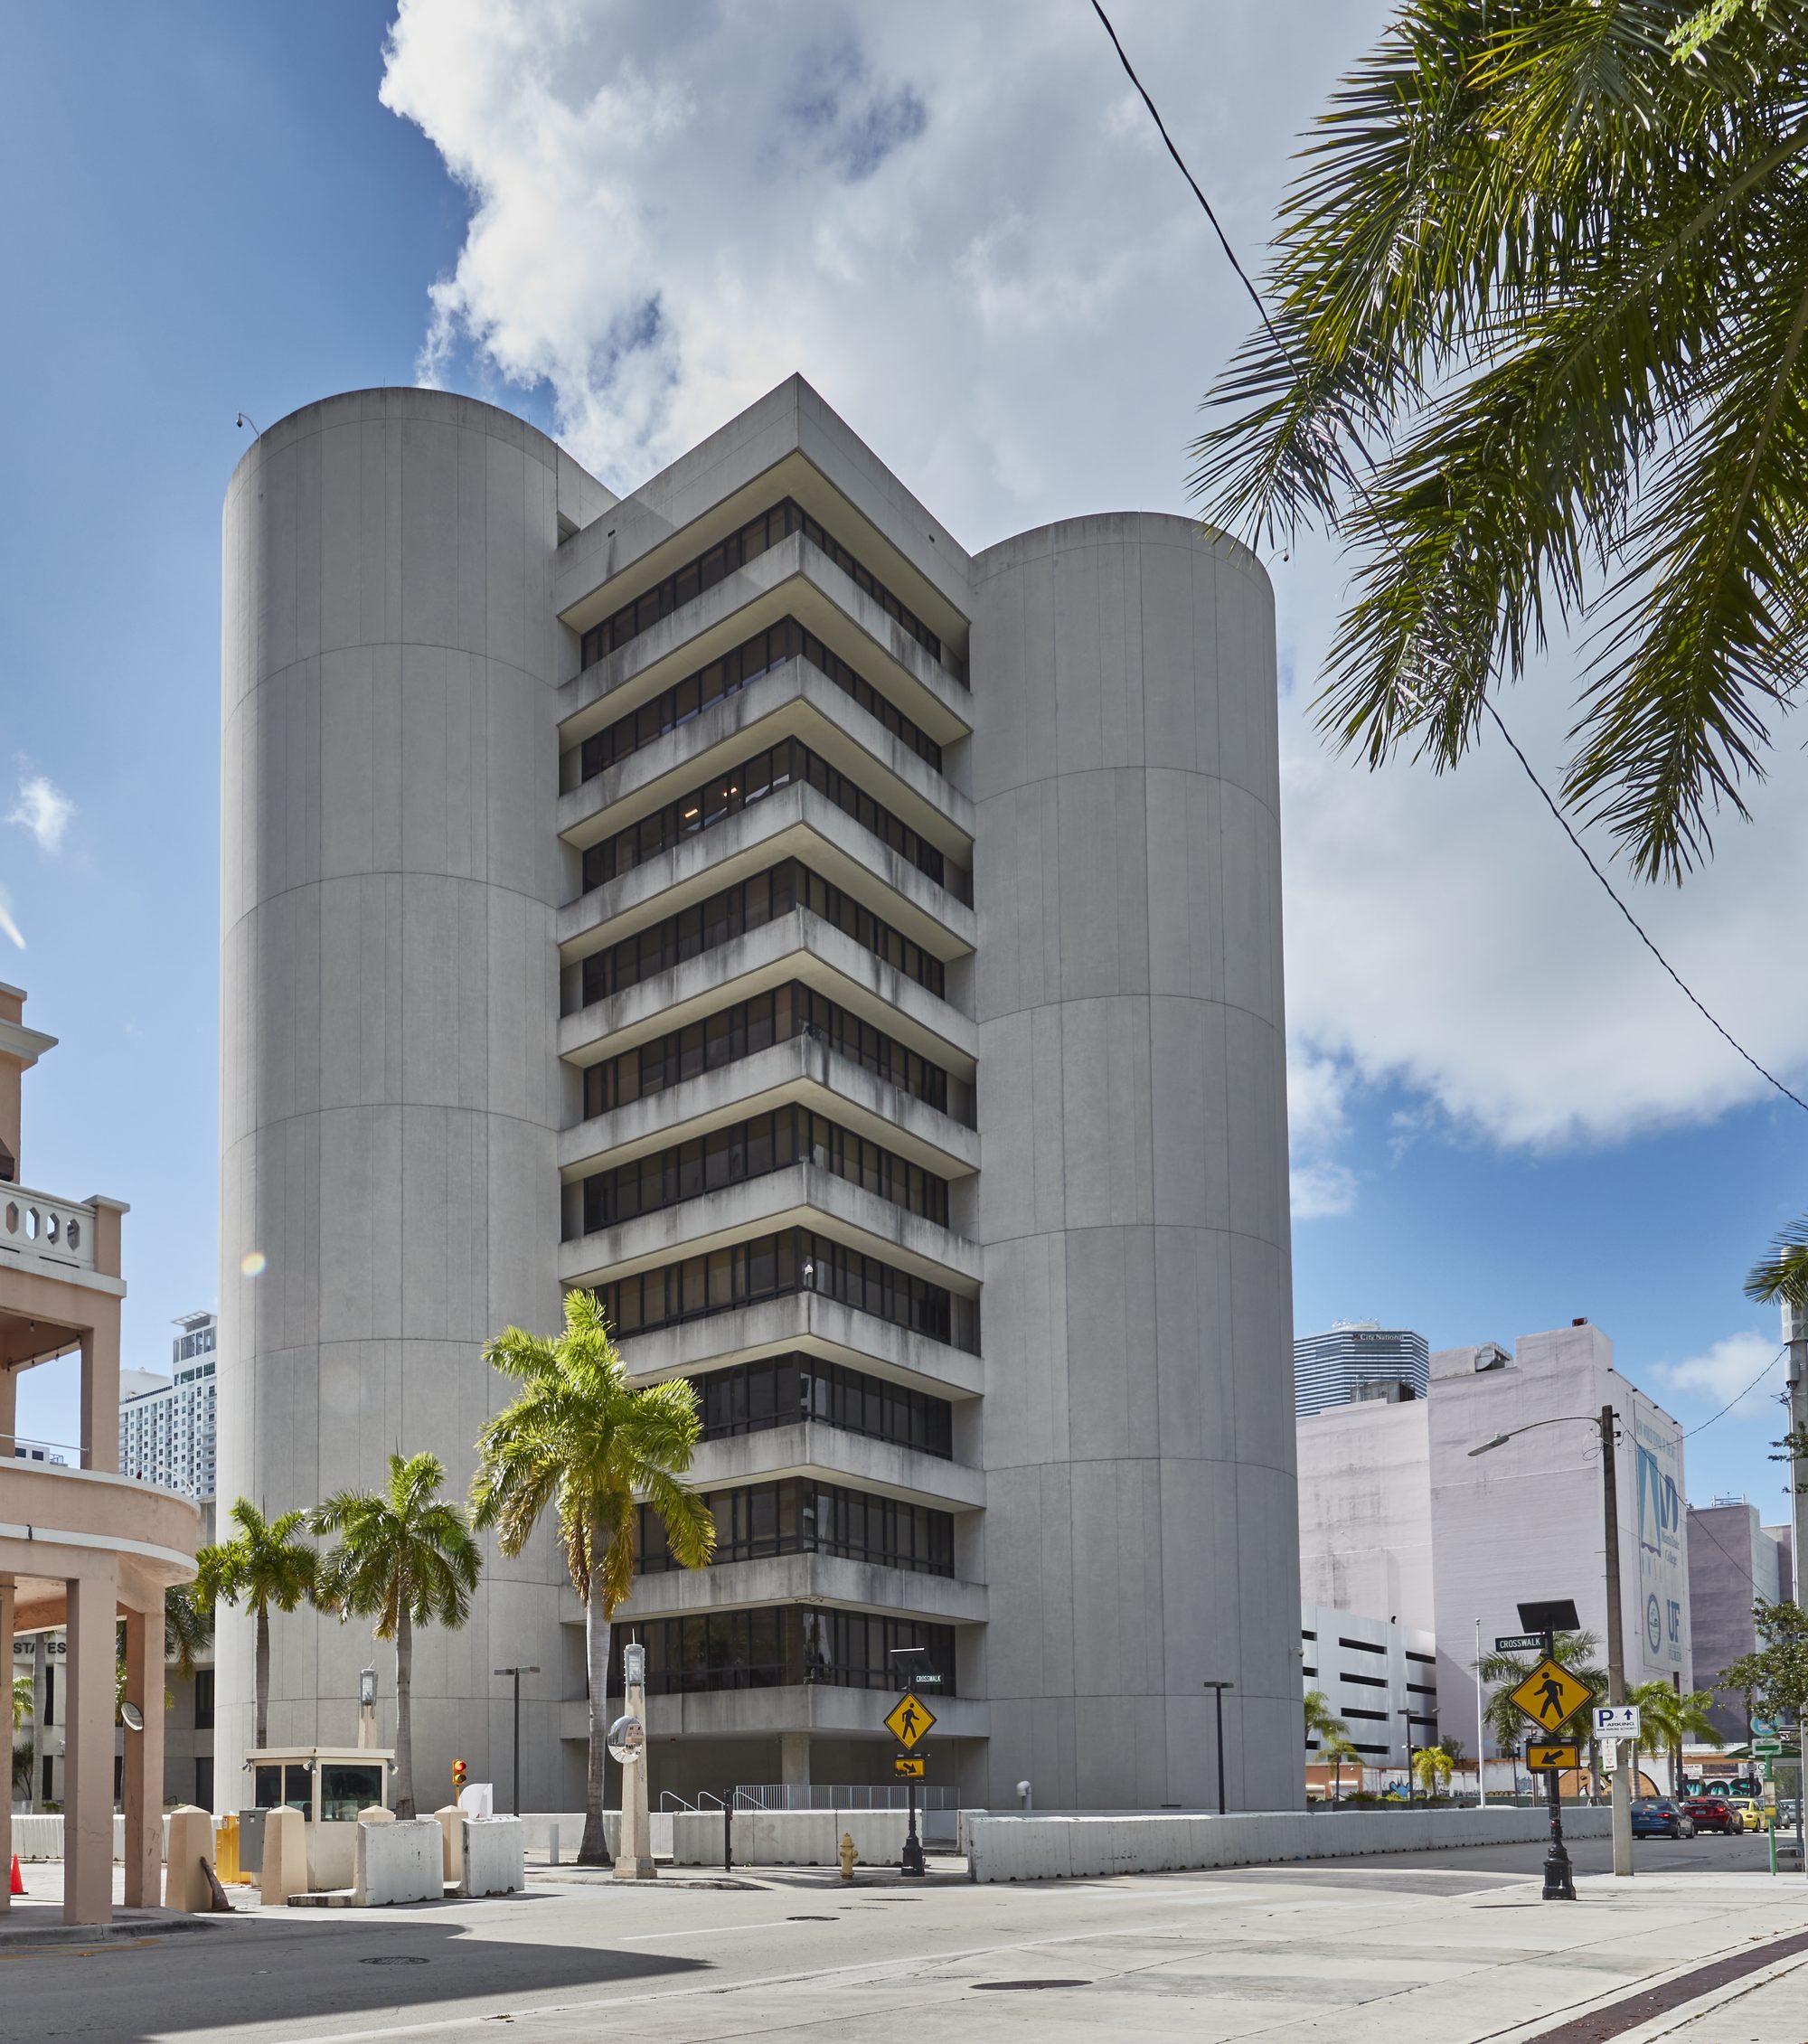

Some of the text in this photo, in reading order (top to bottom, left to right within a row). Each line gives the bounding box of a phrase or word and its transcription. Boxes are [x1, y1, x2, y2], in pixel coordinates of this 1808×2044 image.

[1360, 1333, 1374, 1342] City
[1667, 1599, 1681, 1644] UF
[13, 1642, 67, 1654] STES
[1500, 1637, 1541, 1649] CROSSWALK
[916, 1674, 941, 1682] CROSSWALK
